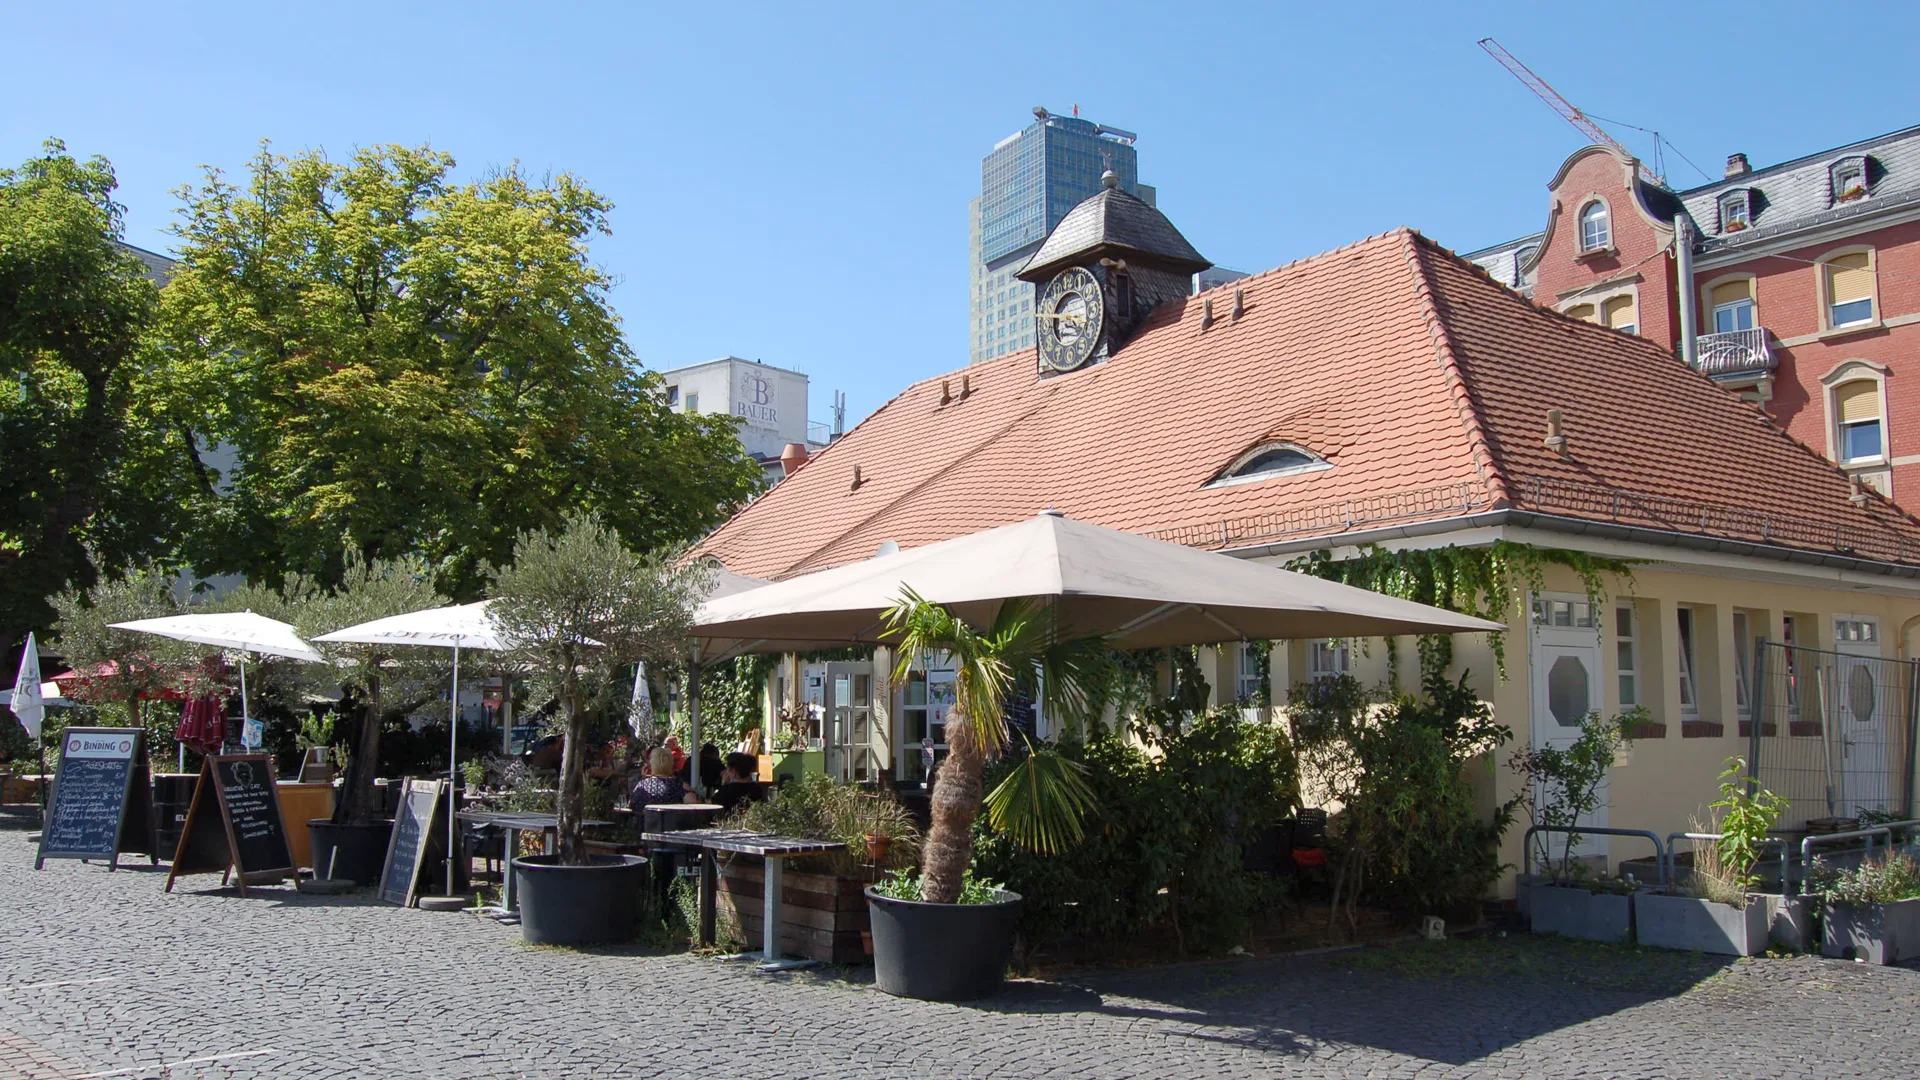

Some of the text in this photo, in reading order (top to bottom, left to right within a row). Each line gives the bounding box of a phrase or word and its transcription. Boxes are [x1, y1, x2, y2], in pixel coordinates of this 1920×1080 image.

[1062, 275, 1074, 290] 12
[1076, 274, 1082, 290] 1
[1053, 283, 1062, 299] 11
[1085, 284, 1094, 301] 2
[1089, 302, 1097, 318] 3
[1043, 320, 1049, 334] 9
[1086, 322, 1094, 338] 4
[1046, 336, 1053, 351] 8
[1077, 338, 1086, 354] 5
[1054, 346, 1062, 361] 7
[1066, 347, 1074, 362] 6
[752, 378, 769, 405] B
[737, 402, 779, 423] BAUER
[83, 741, 116, 751] BINDING
[677, 865, 702, 876] ELE
